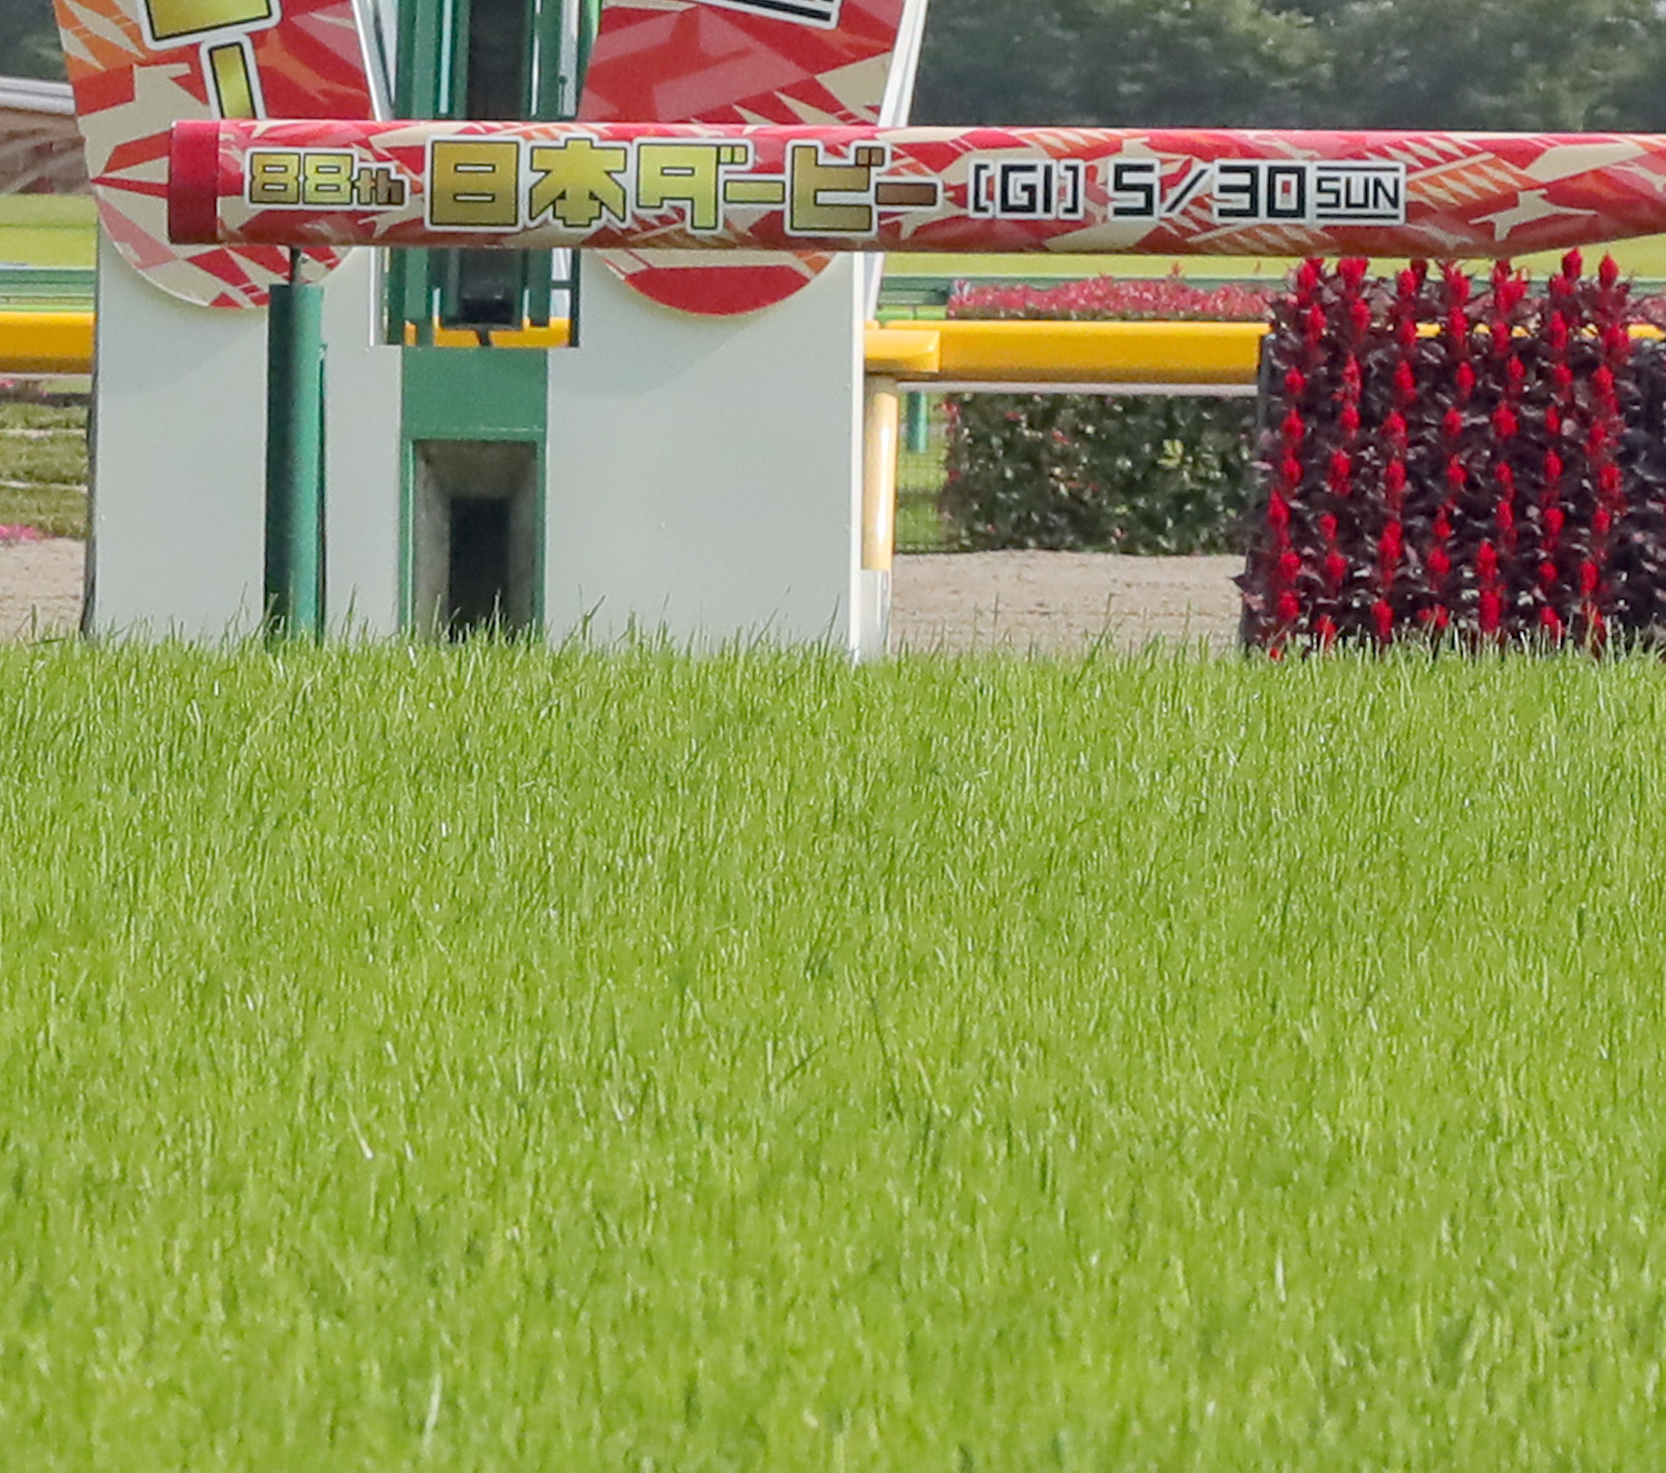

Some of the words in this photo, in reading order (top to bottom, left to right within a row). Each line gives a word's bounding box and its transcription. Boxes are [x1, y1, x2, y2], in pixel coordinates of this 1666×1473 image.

[248, 151, 407, 206] 88th
[428, 138, 939, 231] 日本ダービー
[1316, 173, 1401, 211] SUN
